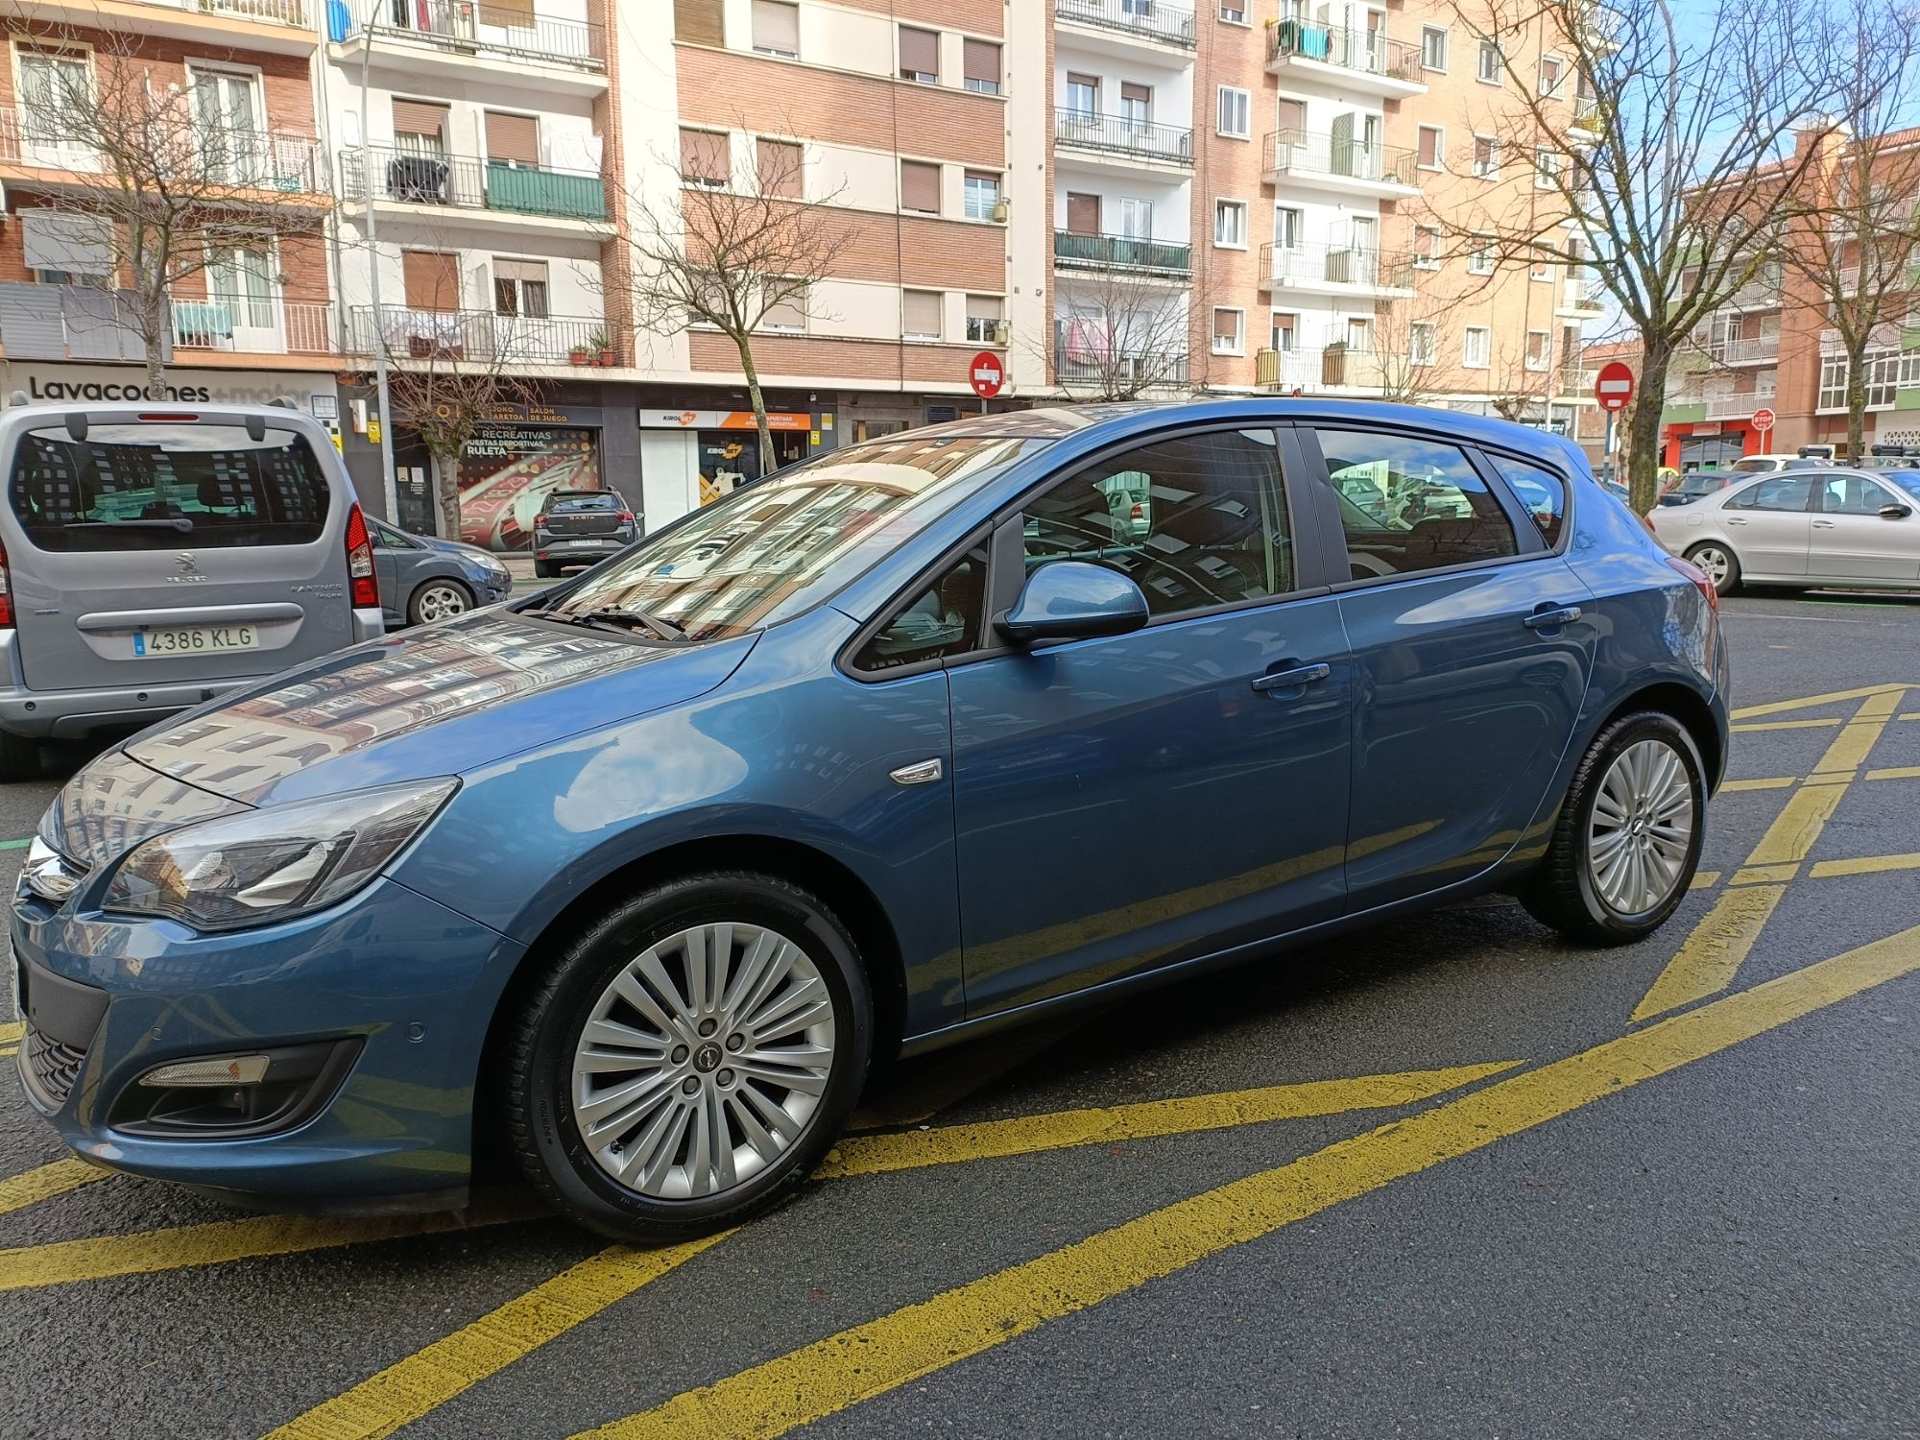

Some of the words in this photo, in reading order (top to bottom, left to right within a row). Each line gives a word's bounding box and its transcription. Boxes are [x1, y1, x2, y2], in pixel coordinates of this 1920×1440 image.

[482, 429, 552, 441] RECREATIVAS
[498, 439, 544, 448] DEPORTIVAS
[467, 446, 508, 456] RULETA
[150, 630, 204, 651] 4386
[211, 628, 251, 647] KLG
